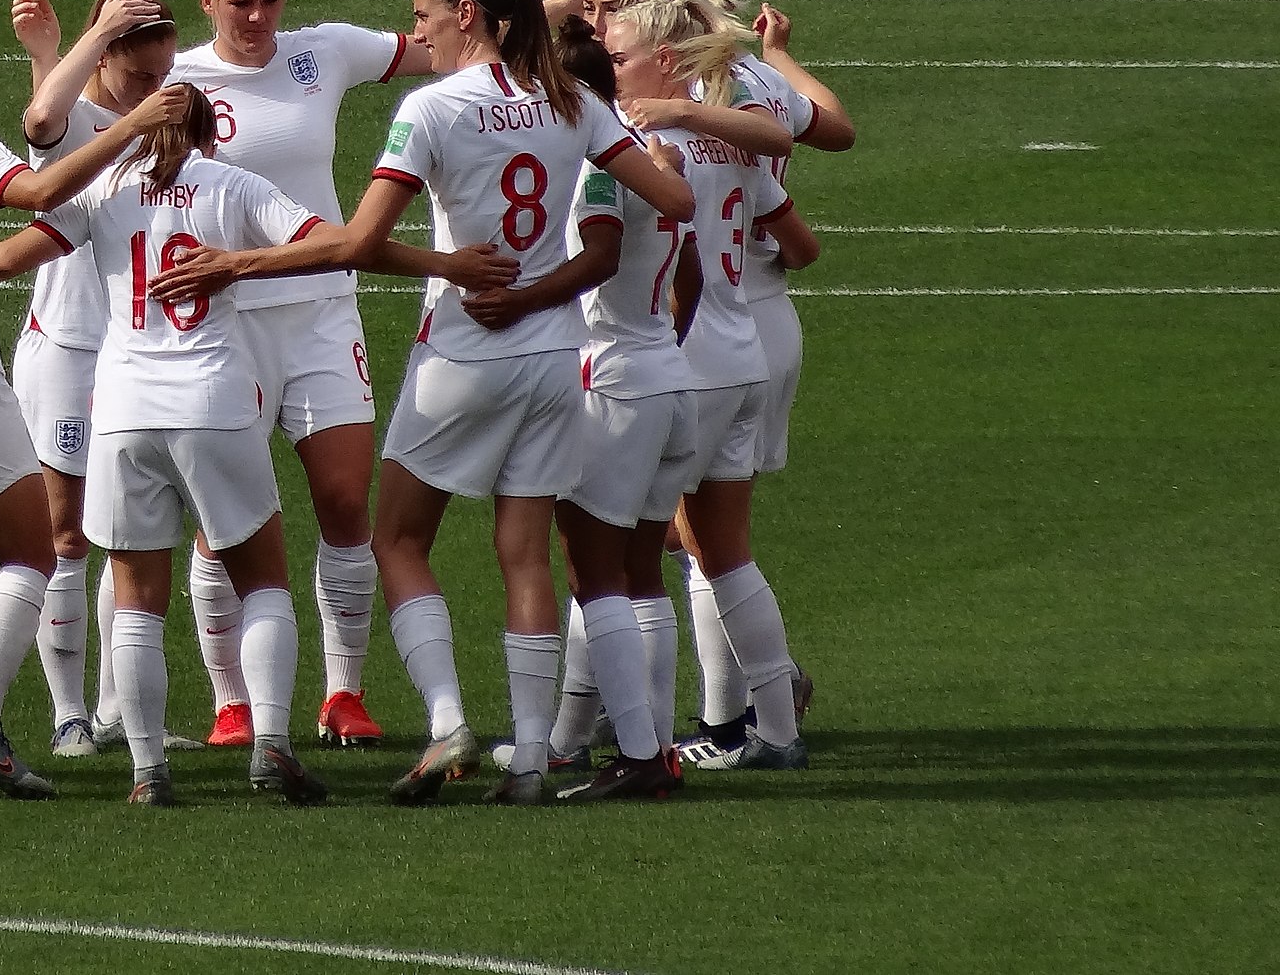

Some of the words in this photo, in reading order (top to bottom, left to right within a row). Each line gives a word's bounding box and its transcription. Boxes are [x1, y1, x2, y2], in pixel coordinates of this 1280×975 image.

[210, 99, 238, 144] 6
[478, 100, 559, 134] J.SCOTT
[140, 181, 200, 209] KIRBY
[500, 151, 549, 253] 8
[721, 186, 745, 288] 3
[649, 216, 682, 316] 7
[352, 341, 371, 387] 6
